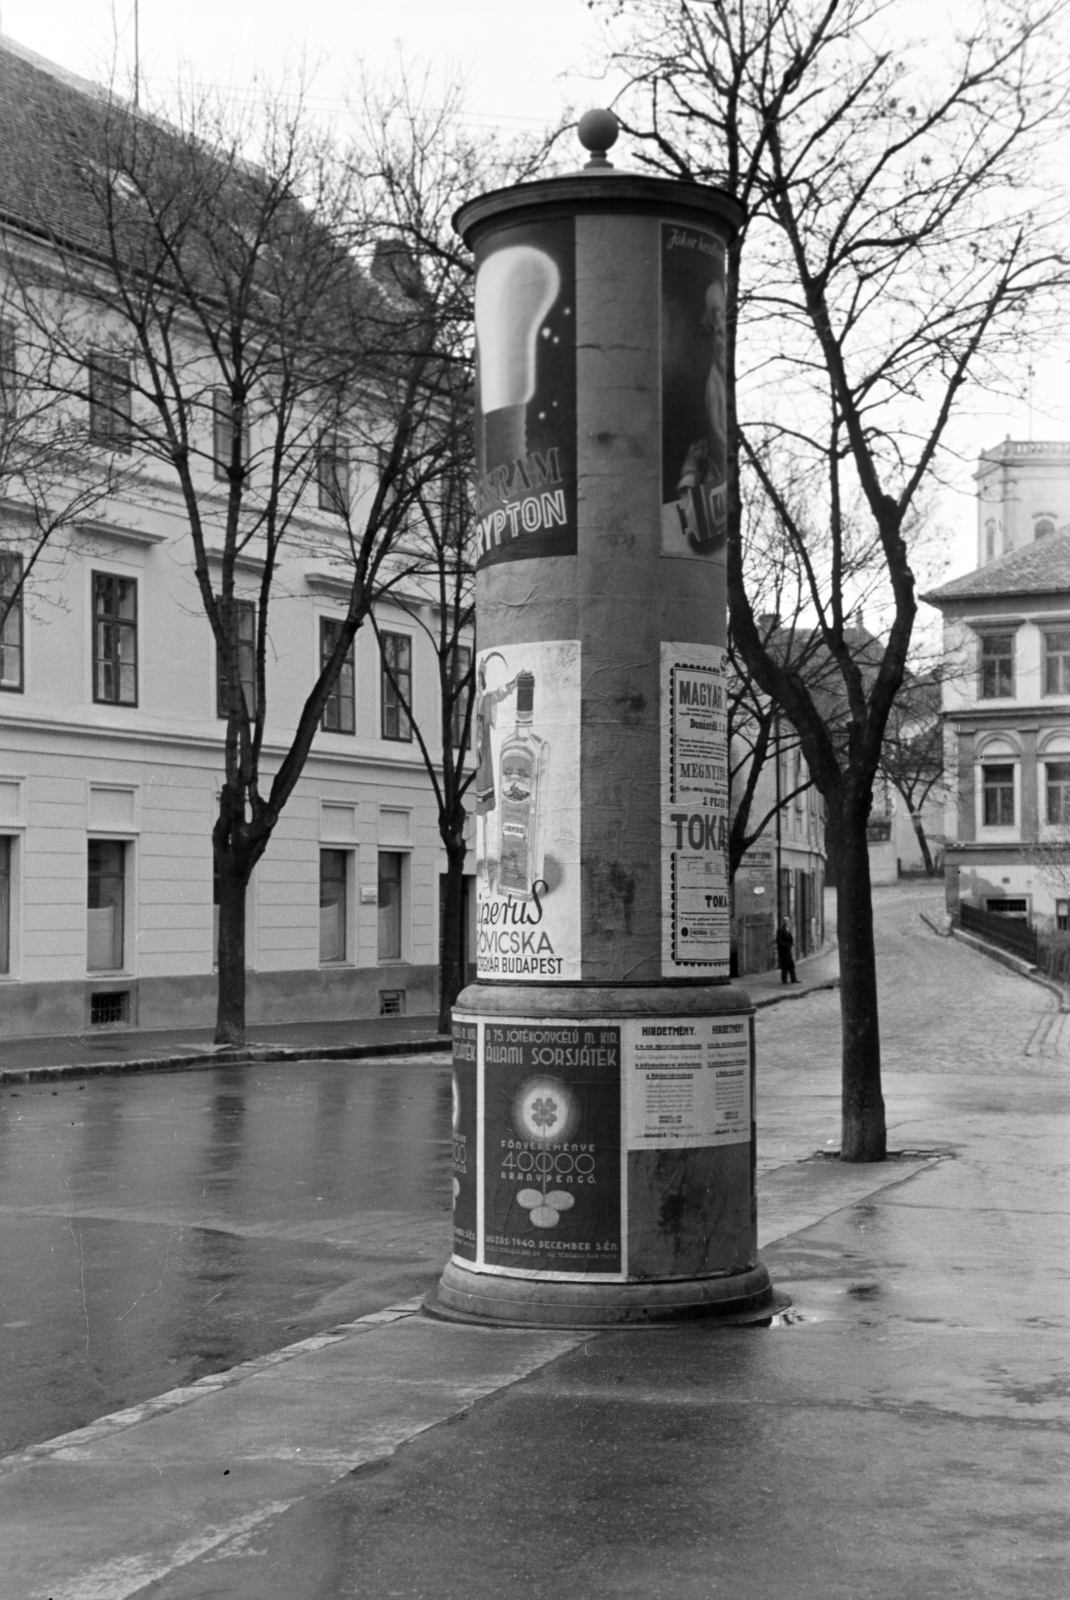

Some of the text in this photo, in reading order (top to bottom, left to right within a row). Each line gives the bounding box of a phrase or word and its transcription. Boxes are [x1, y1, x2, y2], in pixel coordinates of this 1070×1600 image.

[679, 680, 723, 710] MAGYAR
[502, 957, 563, 975] BUDAPEST
[486, 1029, 491, 1040] A
[486, 1042, 617, 1066] ÁLLAMI SORSJÁTÉK
[501, 1139, 595, 1152] FŐNYEREMÉNYE
[501, 1151, 595, 1174] 40.000
[539, 1240, 591, 1251] DECEMBER
